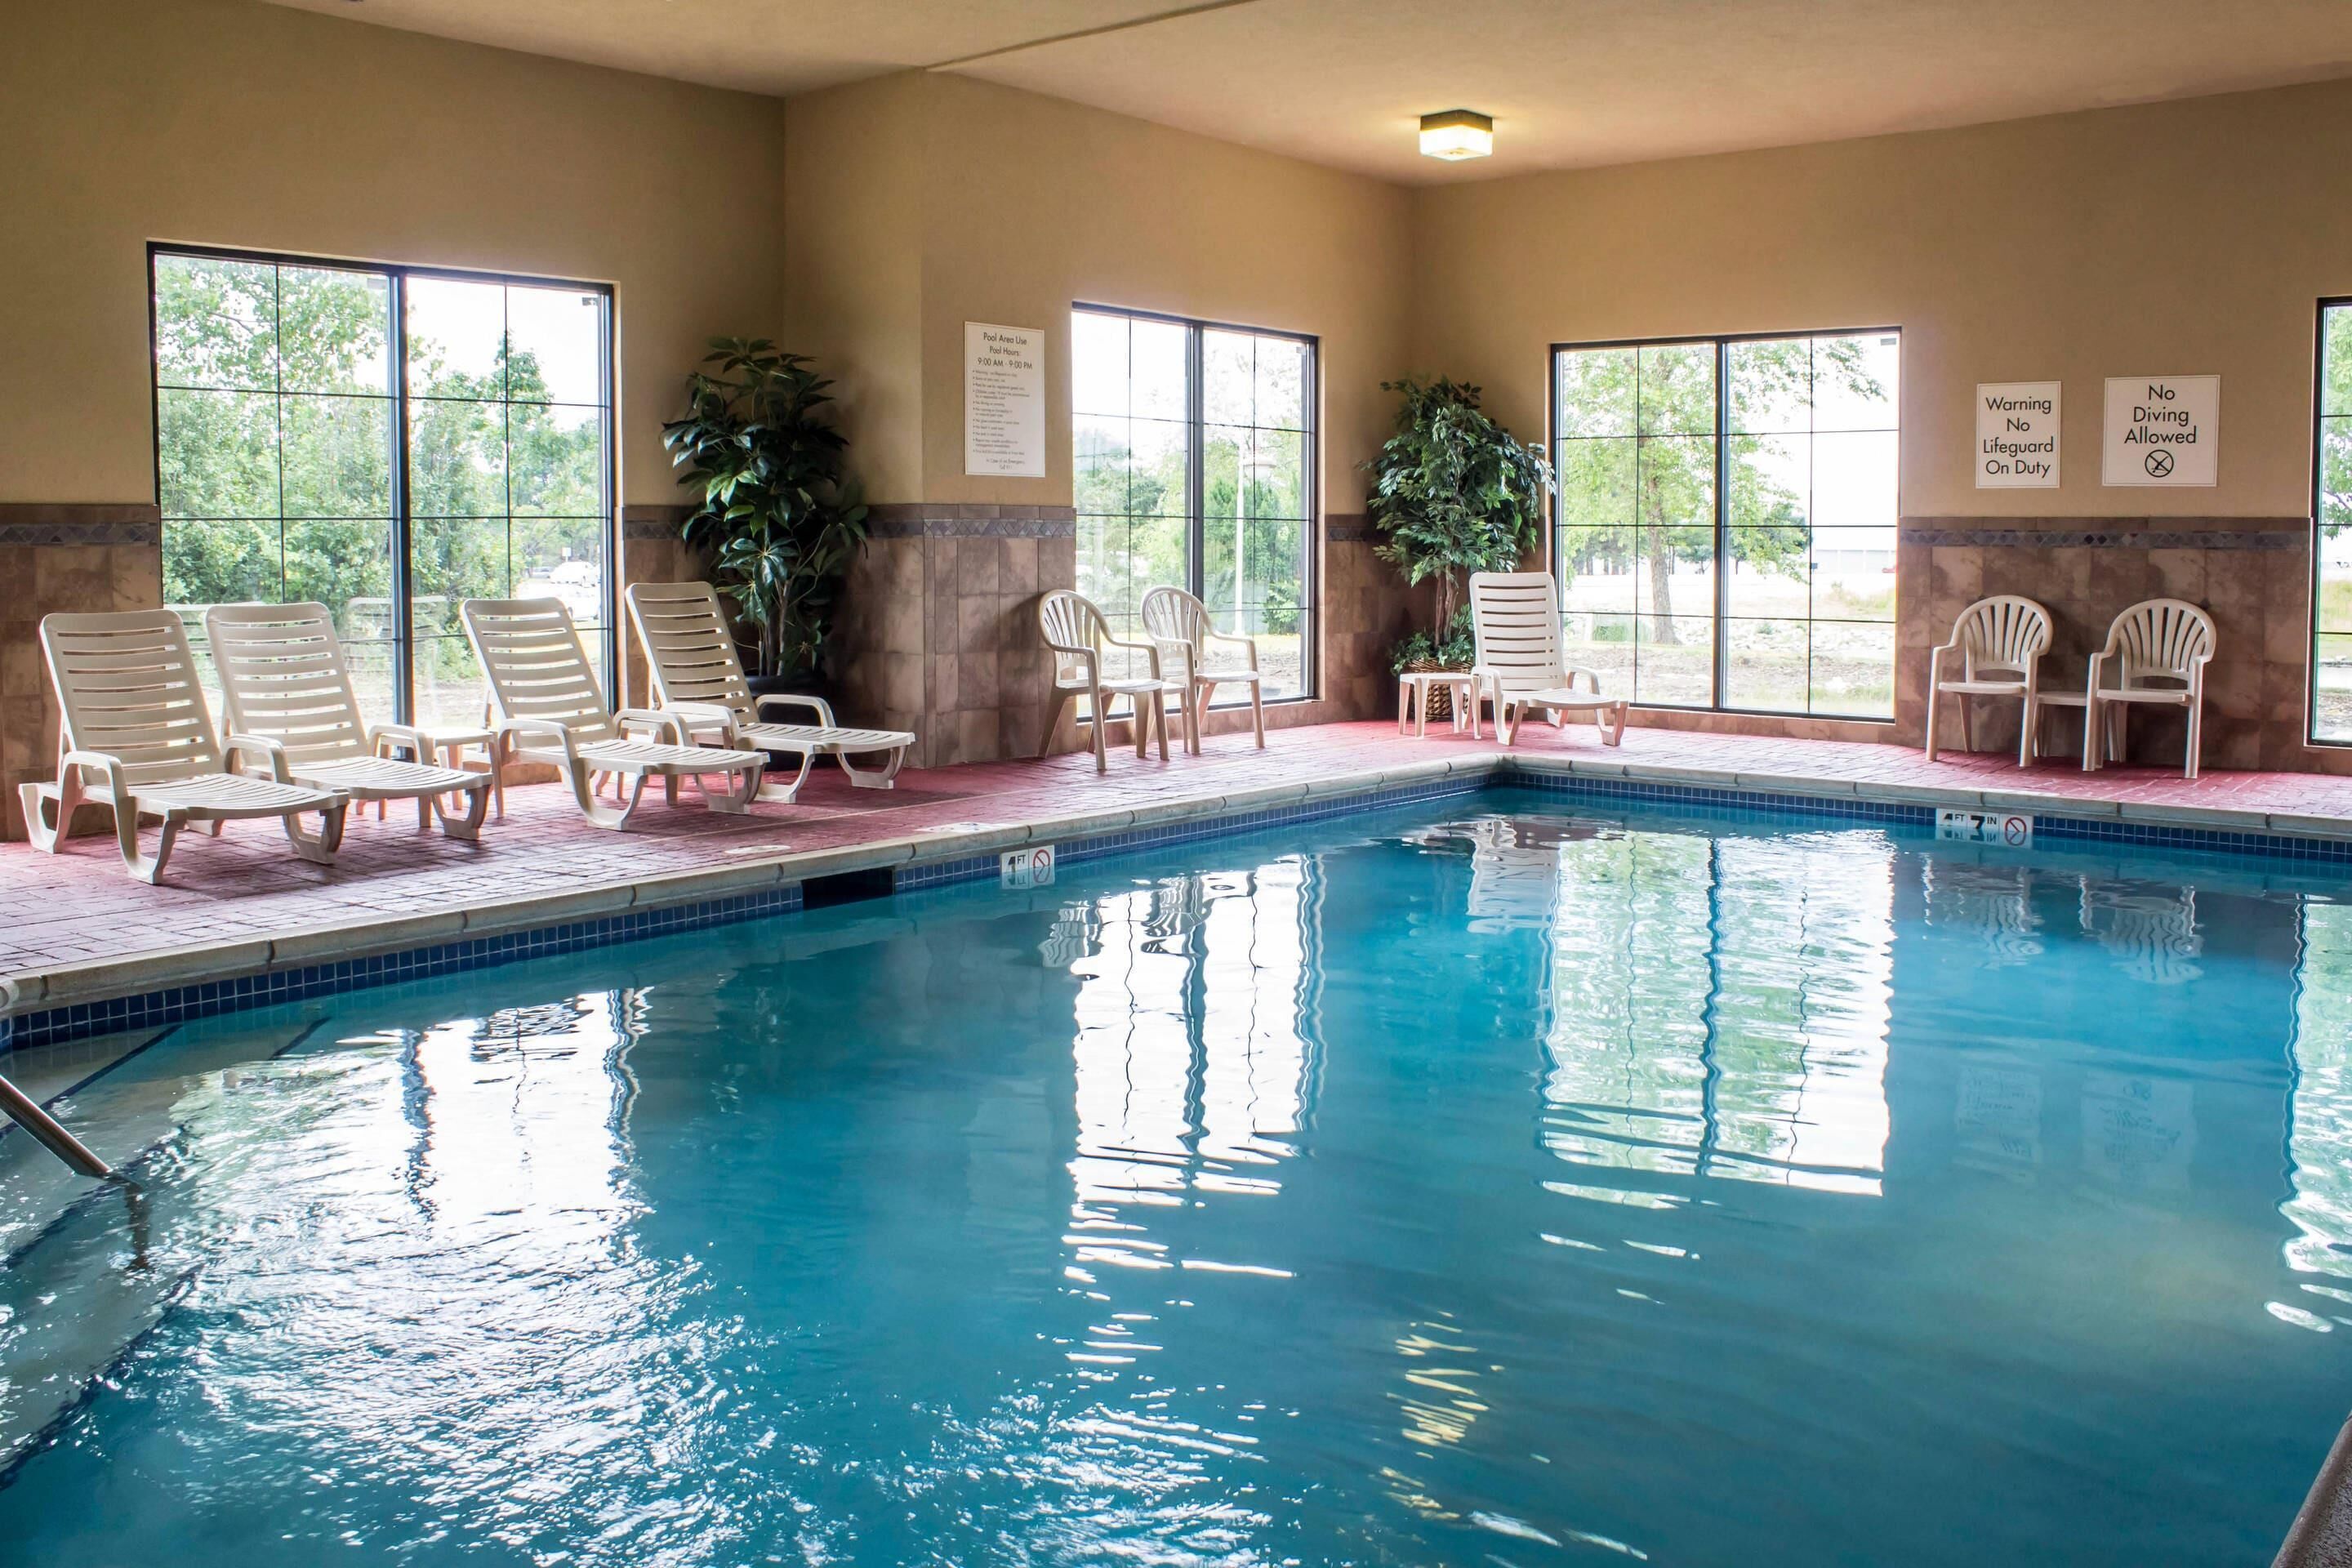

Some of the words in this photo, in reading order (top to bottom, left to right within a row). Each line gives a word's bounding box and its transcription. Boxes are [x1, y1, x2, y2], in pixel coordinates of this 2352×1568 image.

[983, 332, 997, 341] Pool
[999, 334, 1014, 344] Area
[1015, 336, 1027, 345] Use
[989, 345, 1002, 354] Pool
[978, 357, 992, 367] 9:00
[1009, 359, 1022, 369] 9:00
[1023, 361, 1033, 370] PM
[2149, 385, 2175, 400] No
[1985, 396, 2051, 415] Warning
[2007, 417, 2030, 431] No
[2134, 406, 2189, 427] Diving
[2124, 425, 2197, 444] Allowed
[1984, 435, 2054, 457] Lifeguard
[1985, 459, 2009, 474] On
[2015, 459, 2051, 479] Duty
[1955, 814, 1965, 822] FT
[1971, 815, 1985, 829] 7
[1987, 817, 1997, 825] IN
[1017, 855, 1026, 864] FT
